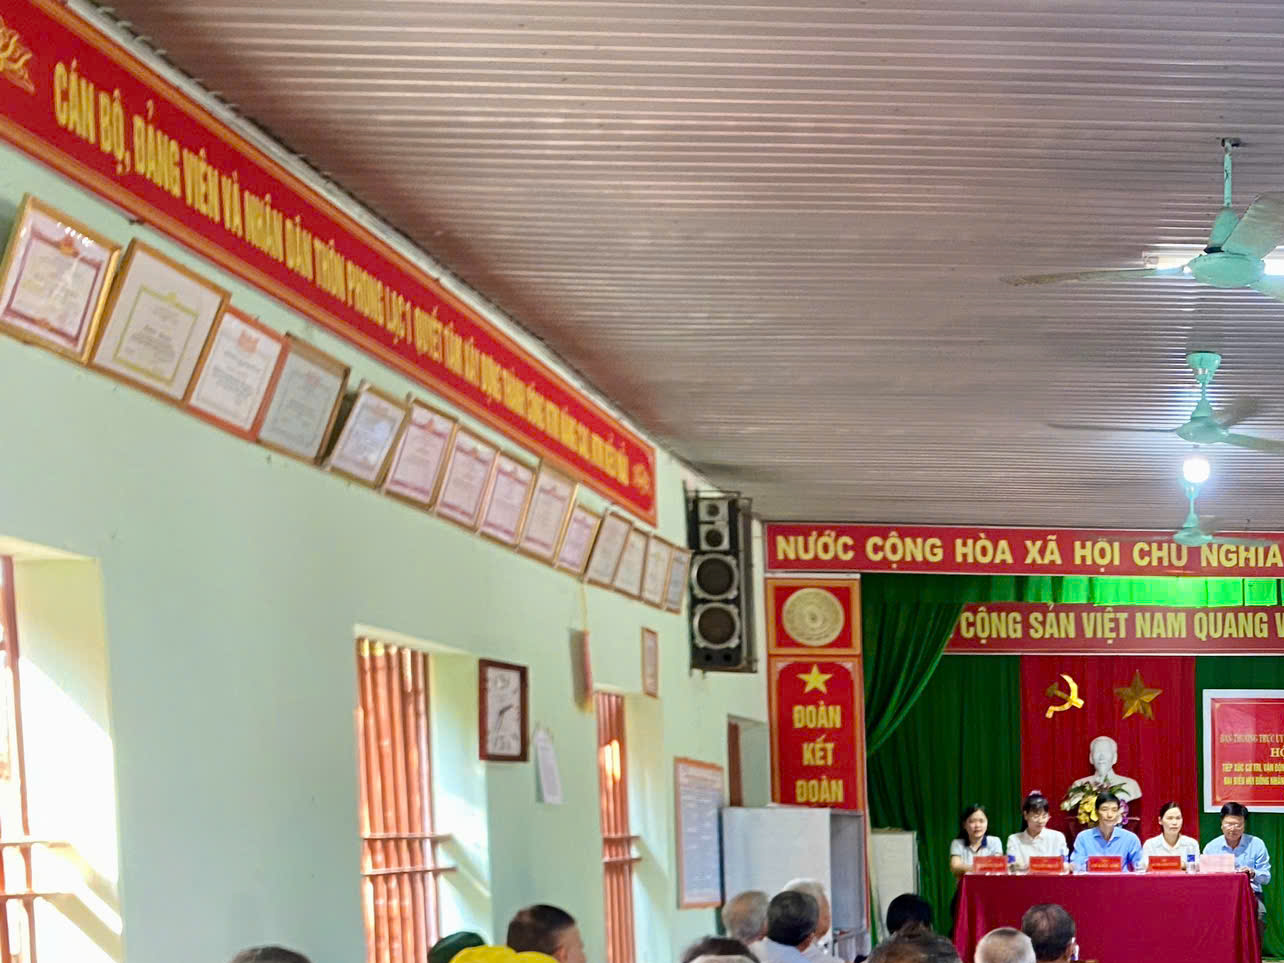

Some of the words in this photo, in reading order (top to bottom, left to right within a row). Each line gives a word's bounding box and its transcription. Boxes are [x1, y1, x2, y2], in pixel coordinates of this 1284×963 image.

[54, 56, 96, 144] CÁN
[100, 88, 131, 175] BỘ,
[133, 99, 181, 198] ĐẢNG
[183, 148, 221, 224] VIÊN
[221, 170, 243, 238] VÀ
[244, 190, 284, 263] NHÂN
[286, 215, 313, 282] DÂN
[775, 529, 854, 561] NƯỚC
[865, 531, 944, 569] CỘNG
[955, 532, 1013, 564] HÒA
[1024, 534, 1063, 565] XÃ
[1073, 539, 1120, 573] HỘI
[959, 606, 1022, 644] CỘNG
[1029, 603, 1075, 639] SẢN
[1082, 607, 1128, 644] VIỆT
[1135, 612, 1187, 638] NAM
[1194, 612, 1269, 642] QUANG
[792, 700, 841, 729] ĐOÀN
[802, 734, 834, 766] KẾT
[795, 775, 844, 803] ĐOÀN
